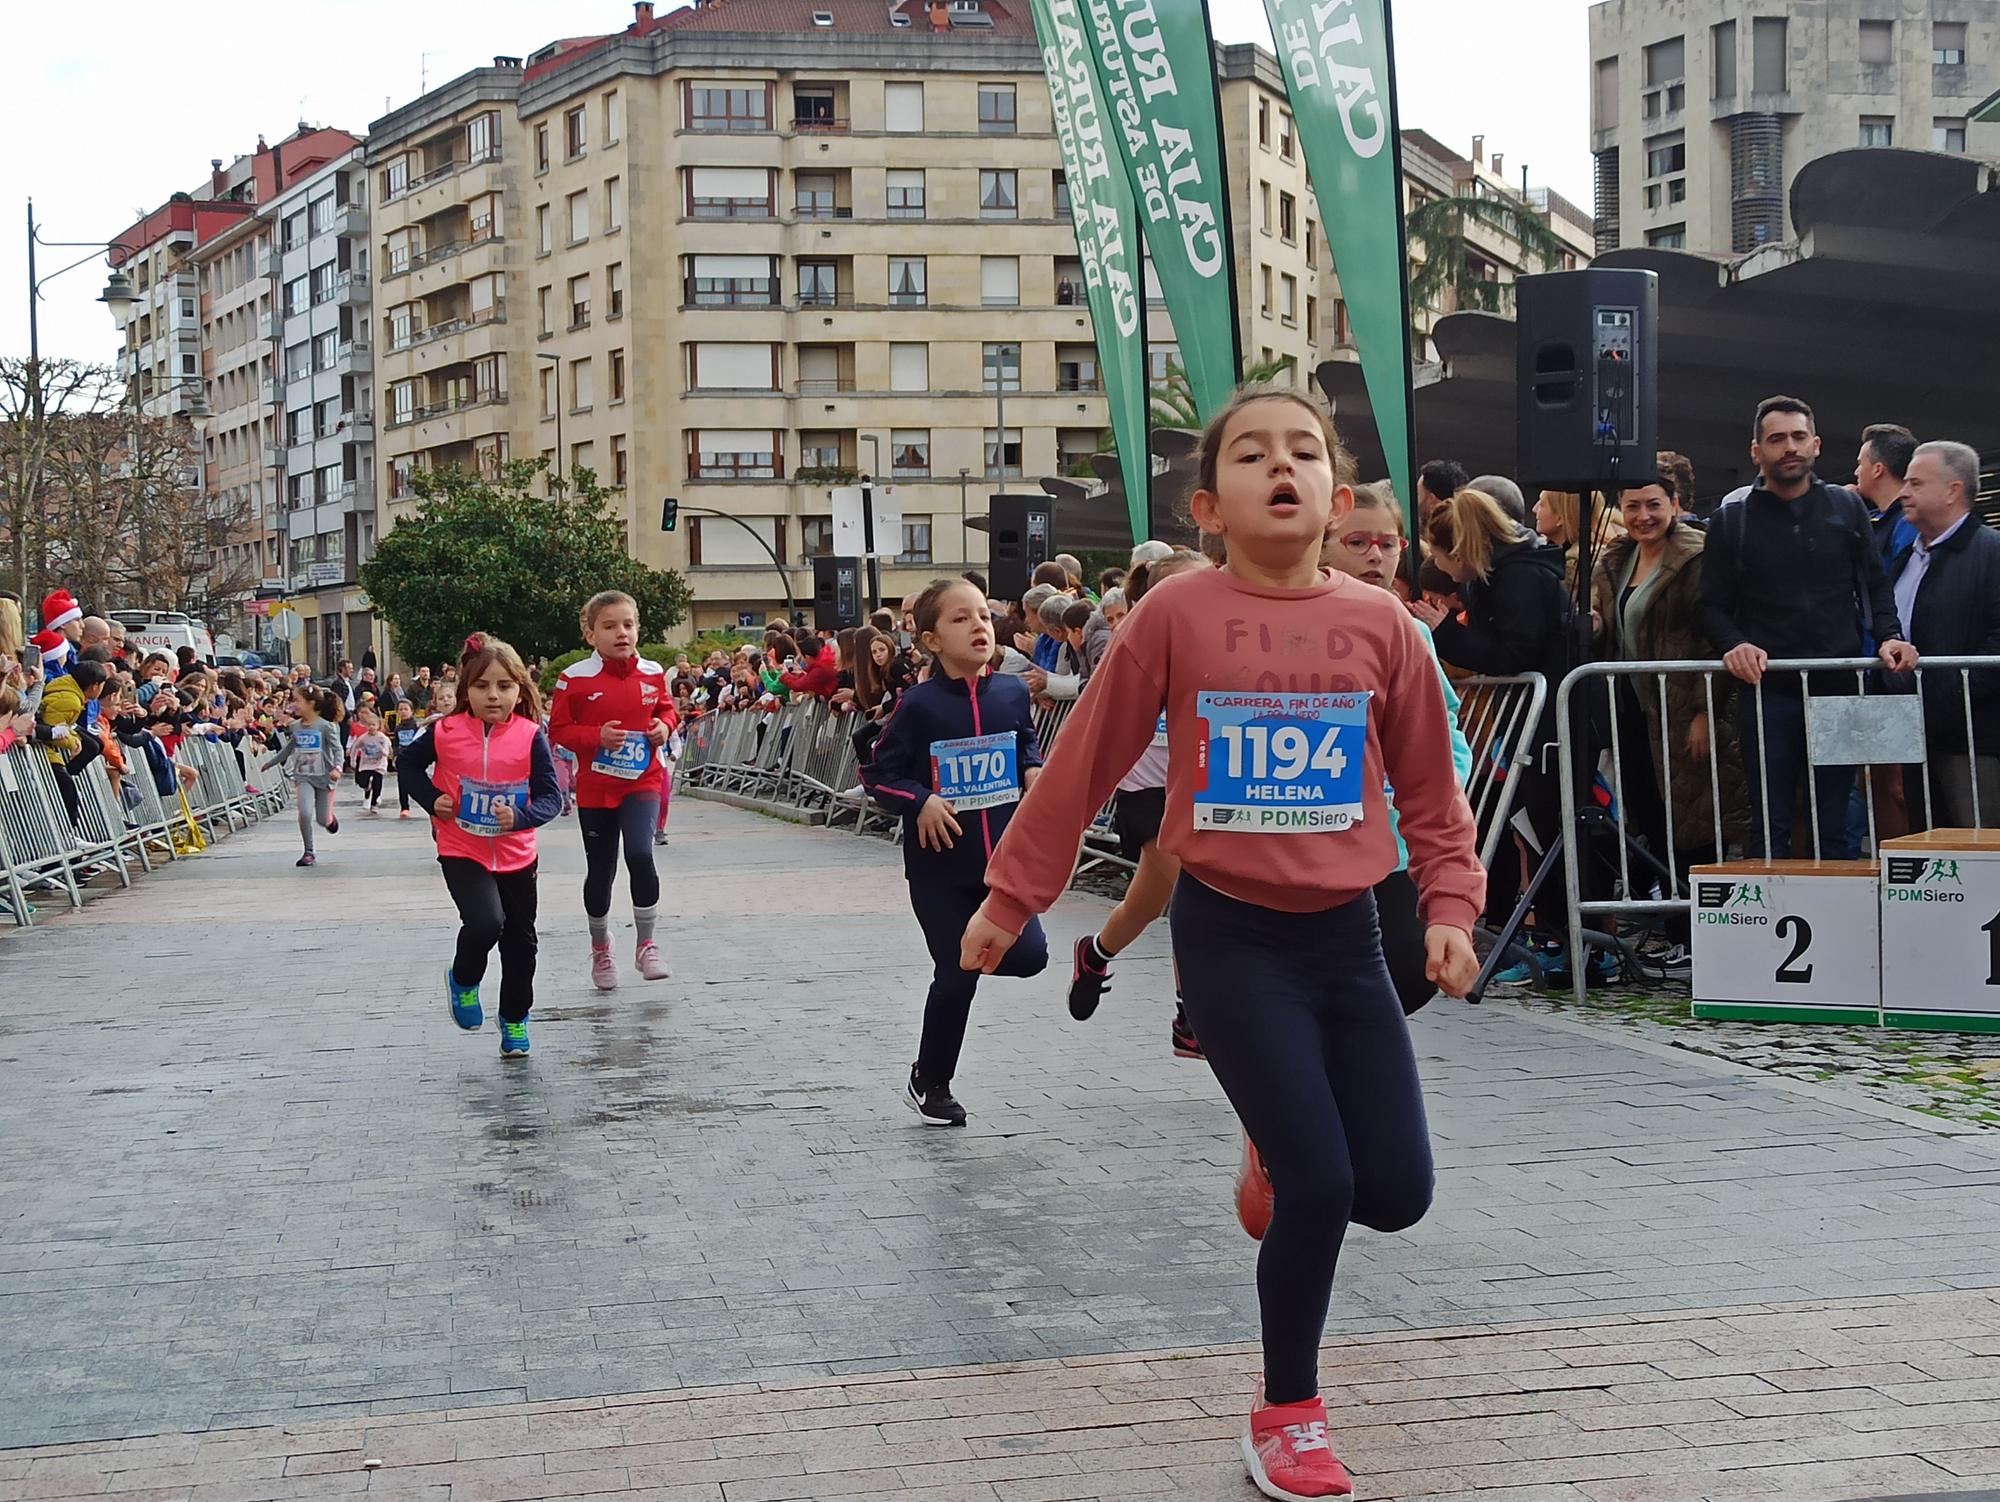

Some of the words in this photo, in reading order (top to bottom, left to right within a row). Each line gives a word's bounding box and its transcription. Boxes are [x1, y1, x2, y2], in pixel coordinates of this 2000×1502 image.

[1224, 618, 1354, 660] FID
[1213, 696, 1284, 709] CARRERA
[1289, 697, 1309, 710] FIN
[1312, 697, 1329, 709] DE
[1331, 695, 1356, 709] AÑO
[1221, 725, 1347, 780] 1194
[945, 751, 1006, 784] 1170
[940, 784, 962, 796] SOL
[963, 778, 1012, 793] VALENTINA
[1245, 784, 1325, 800] HELENA
[1260, 810, 1348, 827] PDMSiero
[1887, 888, 1965, 903] PDMSiero
[1698, 912, 1768, 925] PDMSiero
[1775, 914, 1813, 983] 2
